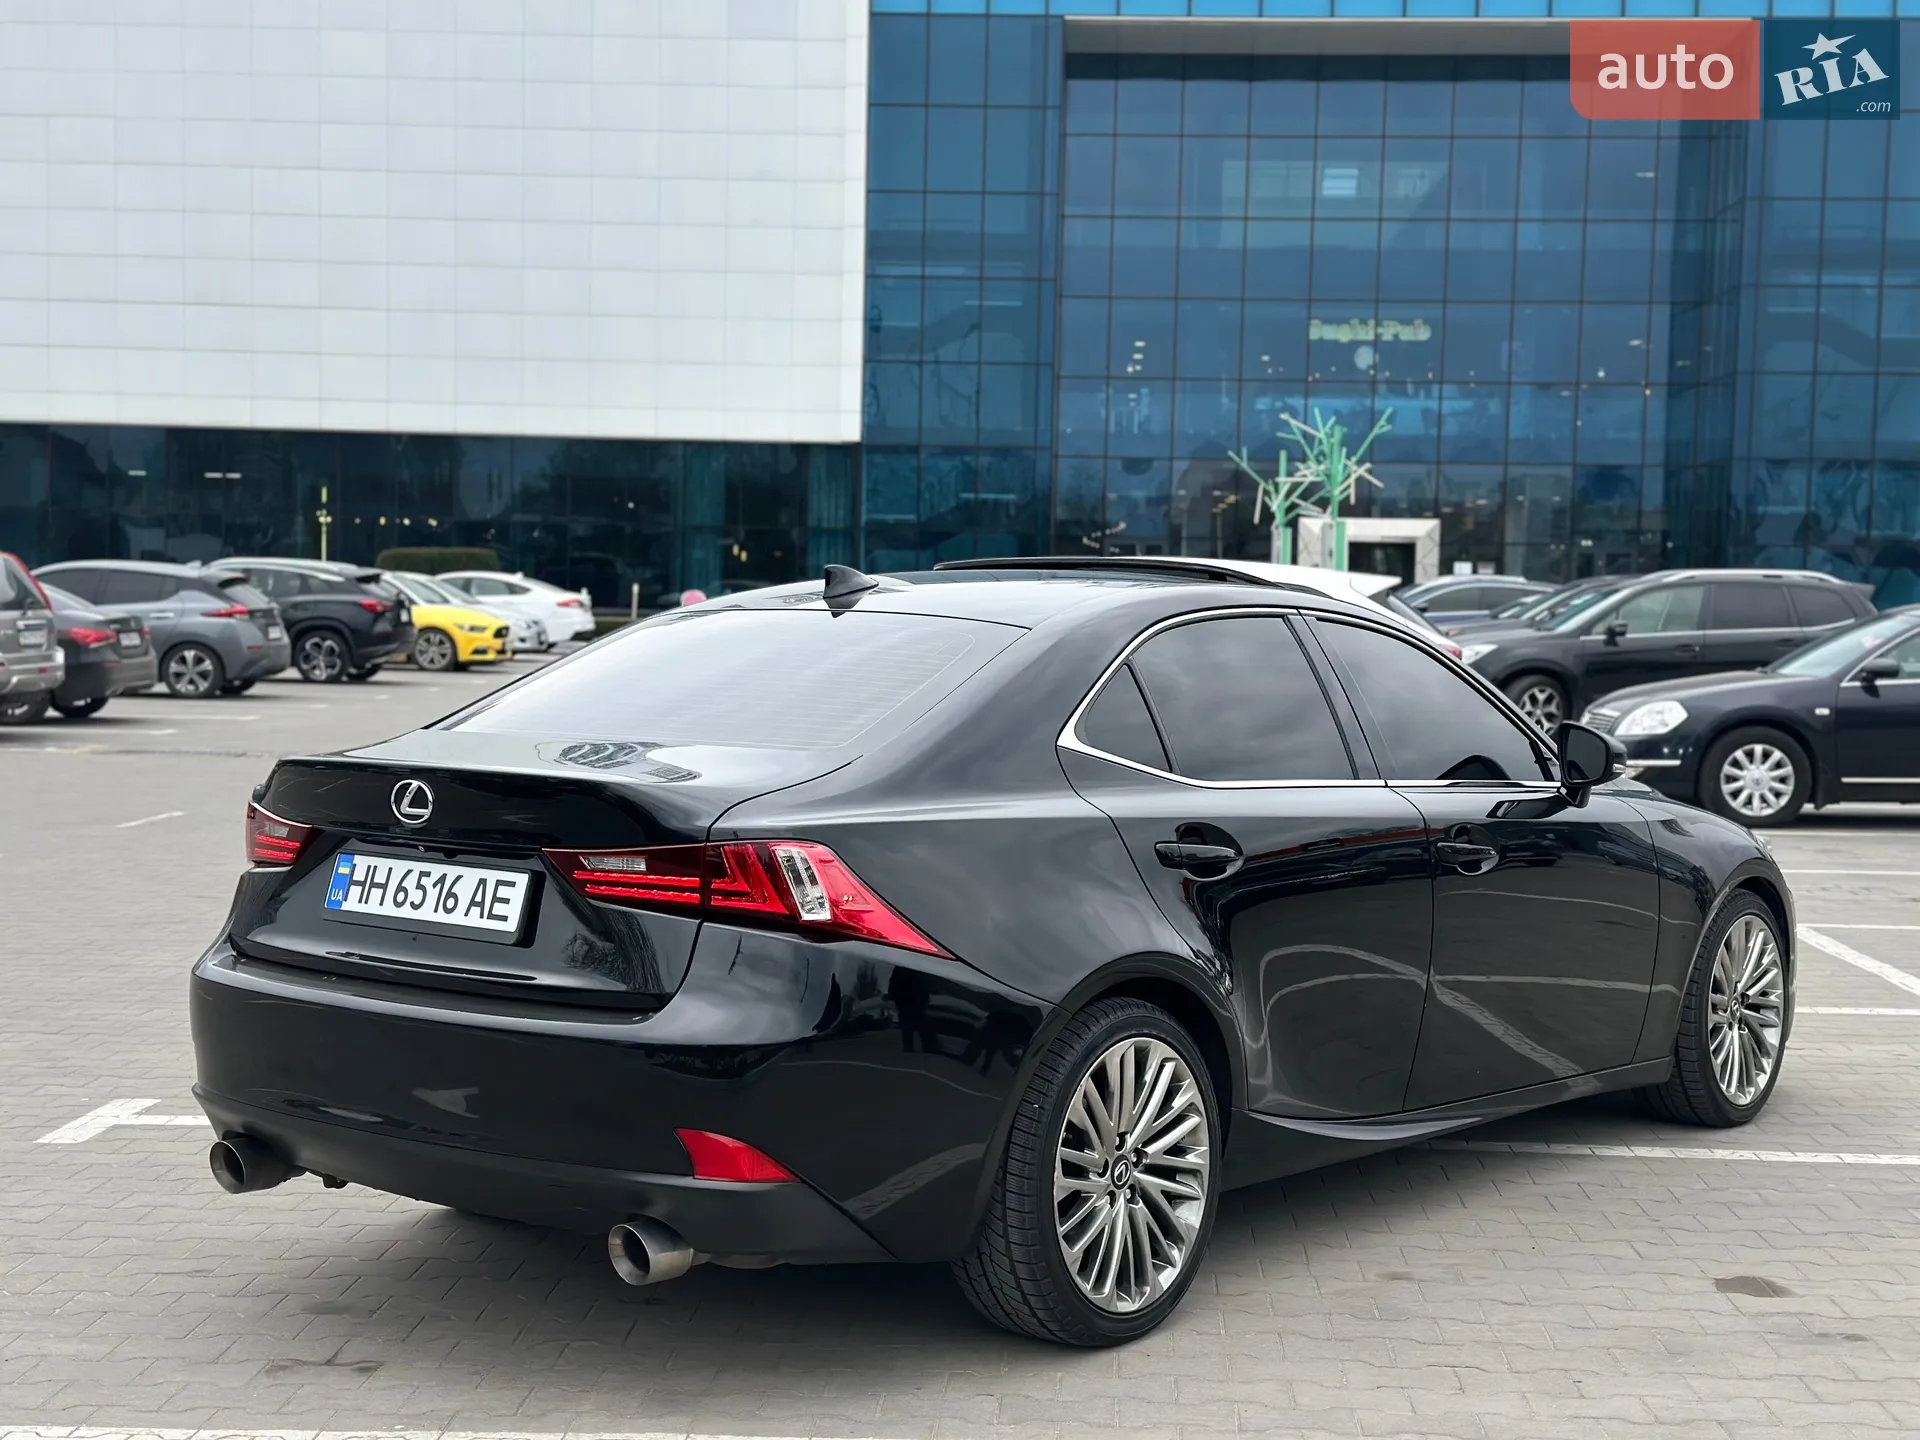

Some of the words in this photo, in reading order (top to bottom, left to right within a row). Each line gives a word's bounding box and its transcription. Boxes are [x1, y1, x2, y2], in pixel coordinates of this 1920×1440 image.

[331, 888, 343, 901] UA
[344, 863, 392, 907] HH
[393, 868, 463, 915] 6516
[464, 877, 516, 923] AE
